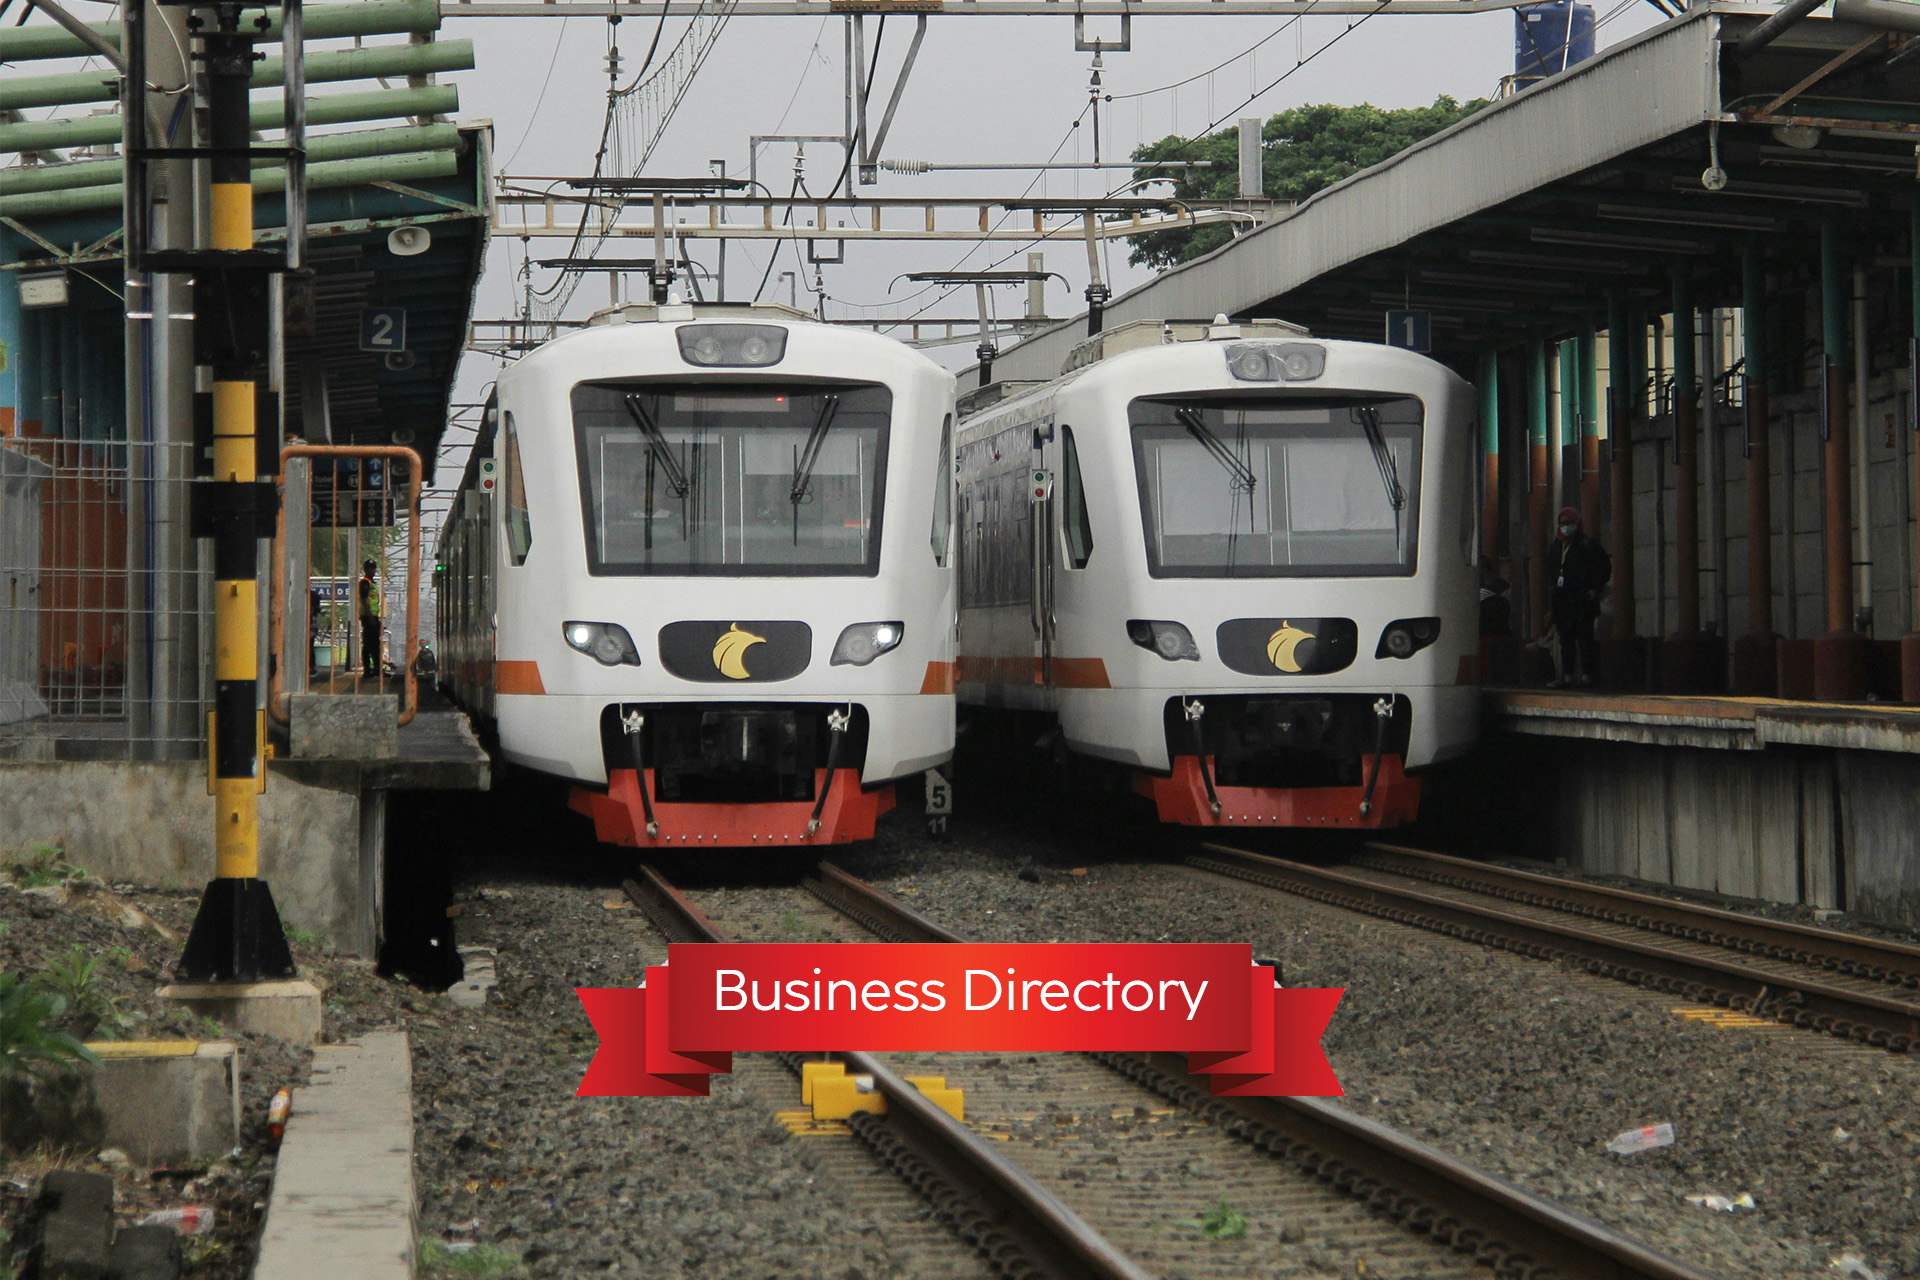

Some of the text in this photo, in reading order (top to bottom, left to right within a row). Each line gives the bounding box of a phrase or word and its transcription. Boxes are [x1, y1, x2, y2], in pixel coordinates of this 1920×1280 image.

[371, 313, 393, 344] 2
[1402, 316, 1414, 346] 1
[932, 786, 946, 809] 5
[928, 816, 946, 834] 11
